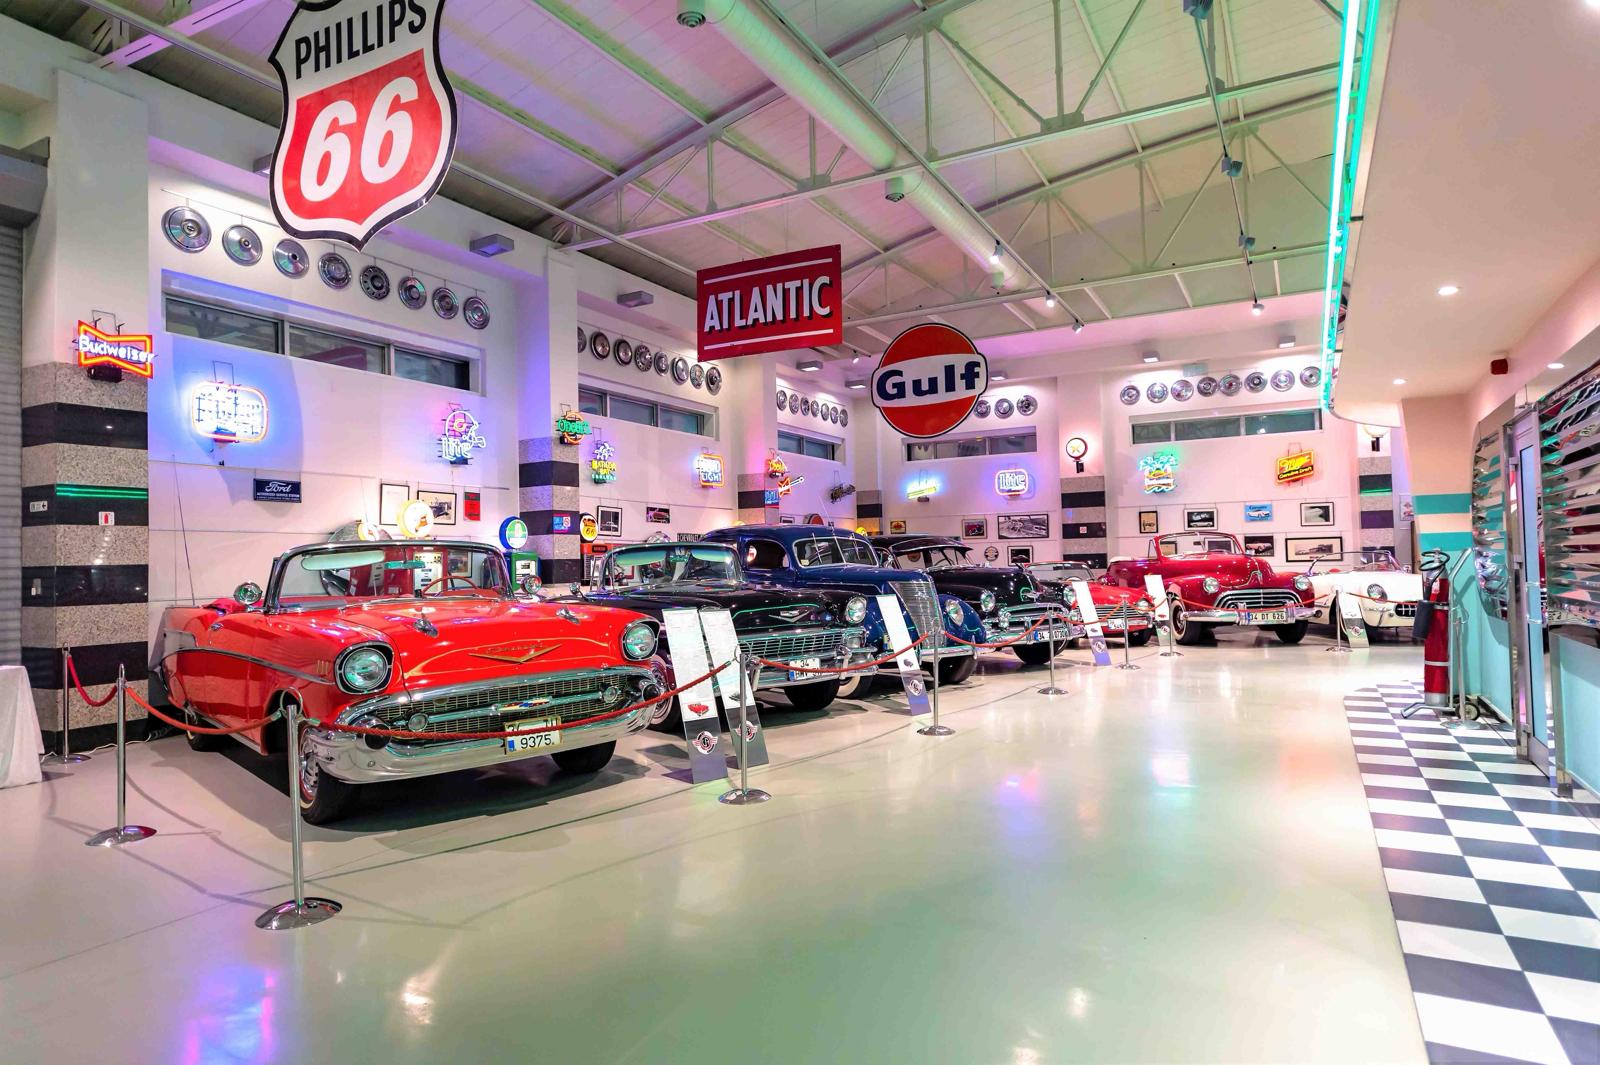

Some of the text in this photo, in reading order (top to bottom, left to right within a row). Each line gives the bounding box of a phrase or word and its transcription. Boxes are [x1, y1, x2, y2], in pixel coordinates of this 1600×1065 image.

[295, 0, 427, 80] PHILLIPS
[300, 76, 419, 202] 66
[704, 275, 832, 334] ATLANTIC
[79, 334, 155, 363] Budweiser
[876, 361, 981, 402] Gulf
[265, 481, 292, 493] Ford
[520, 733, 552, 749] 9375
